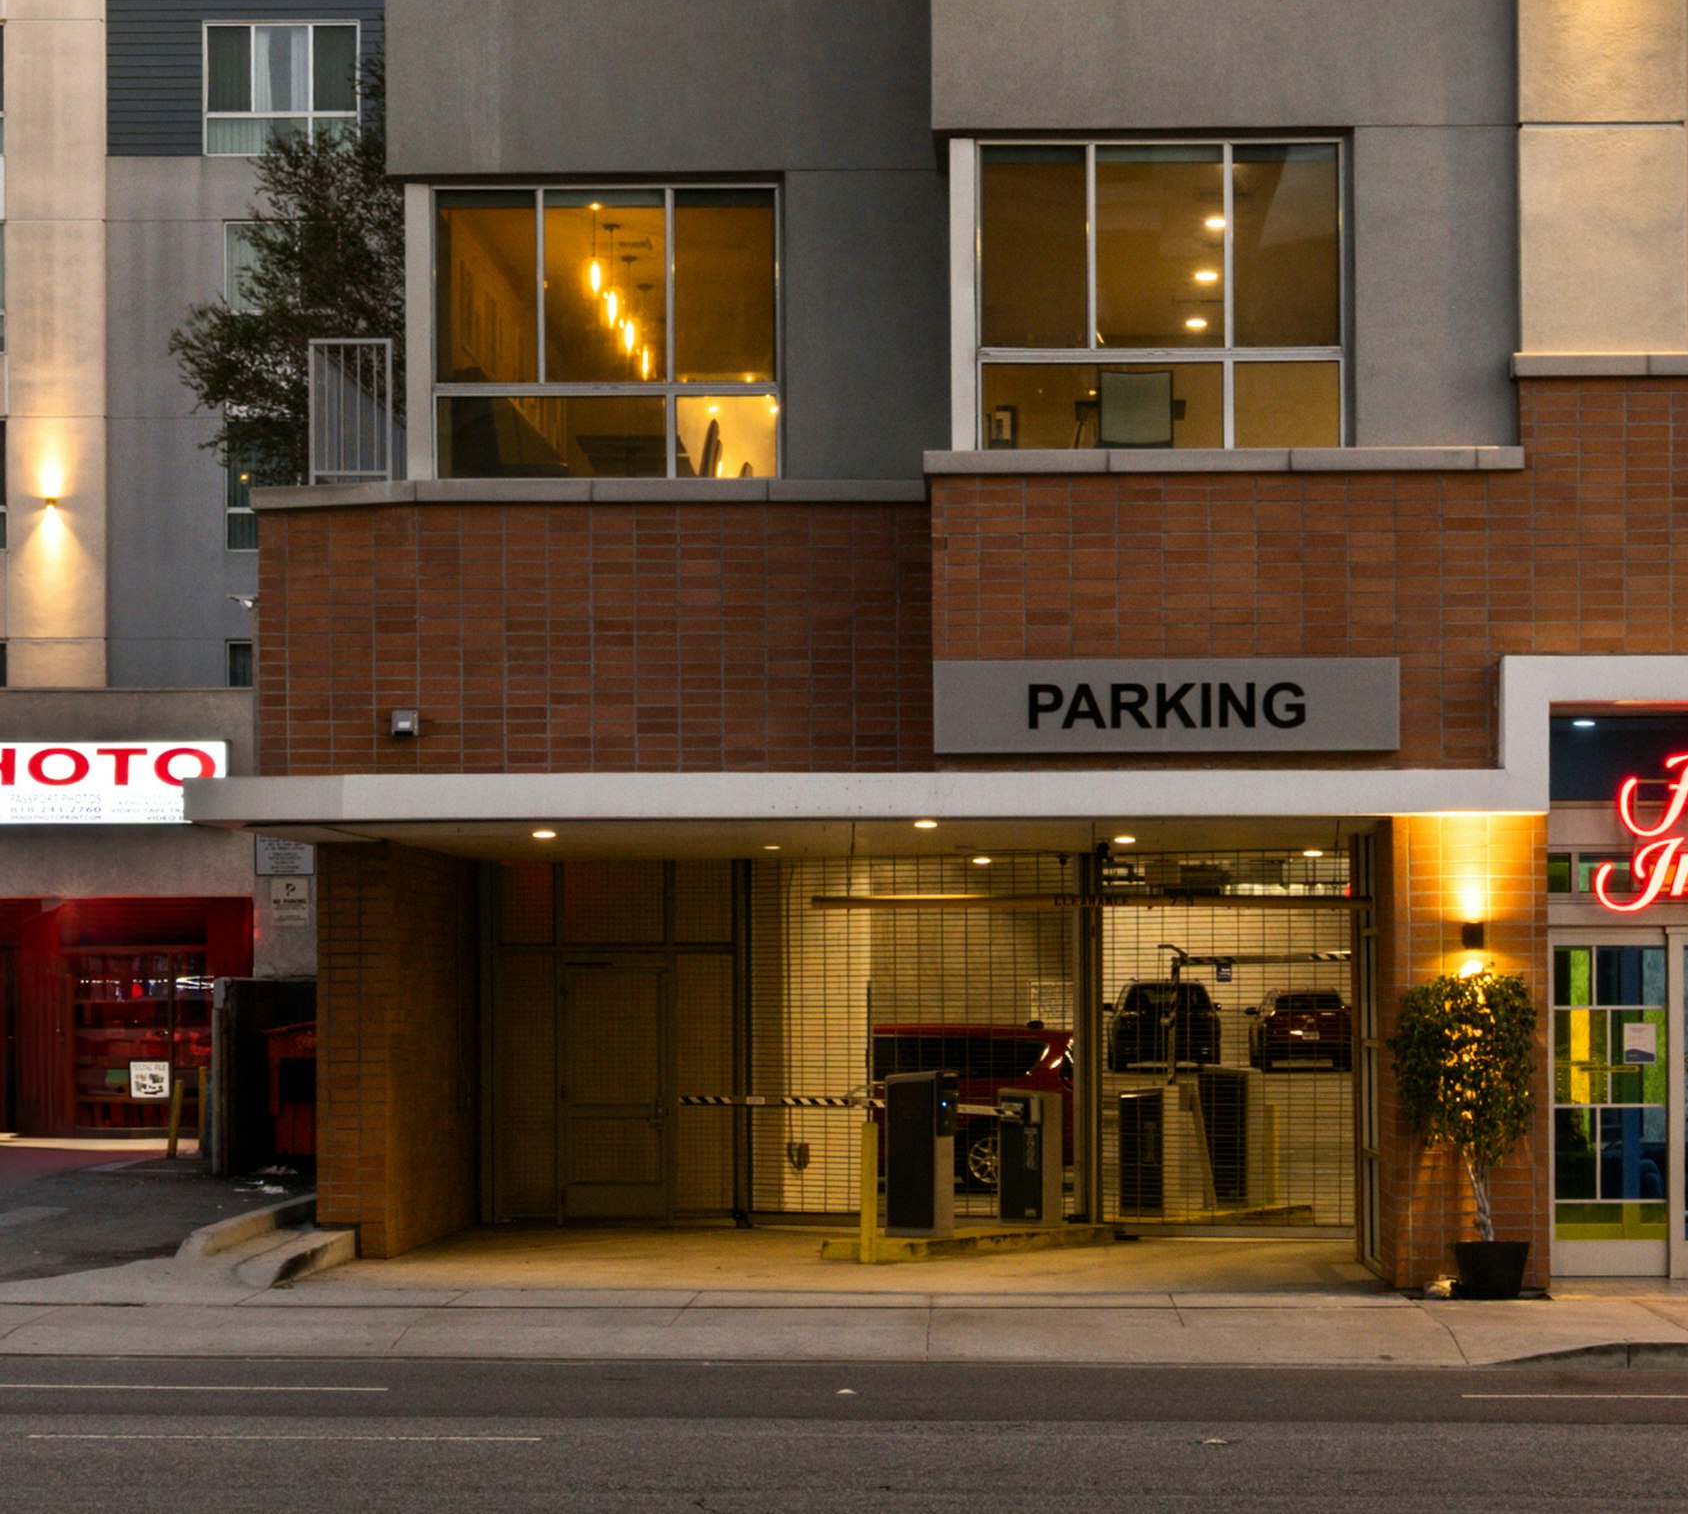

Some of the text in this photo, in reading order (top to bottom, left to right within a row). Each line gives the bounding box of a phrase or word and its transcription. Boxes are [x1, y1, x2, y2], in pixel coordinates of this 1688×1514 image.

[1028, 681, 1306, 729] PARKING
[10, 793, 102, 804] PASSPORT PHOTOS
